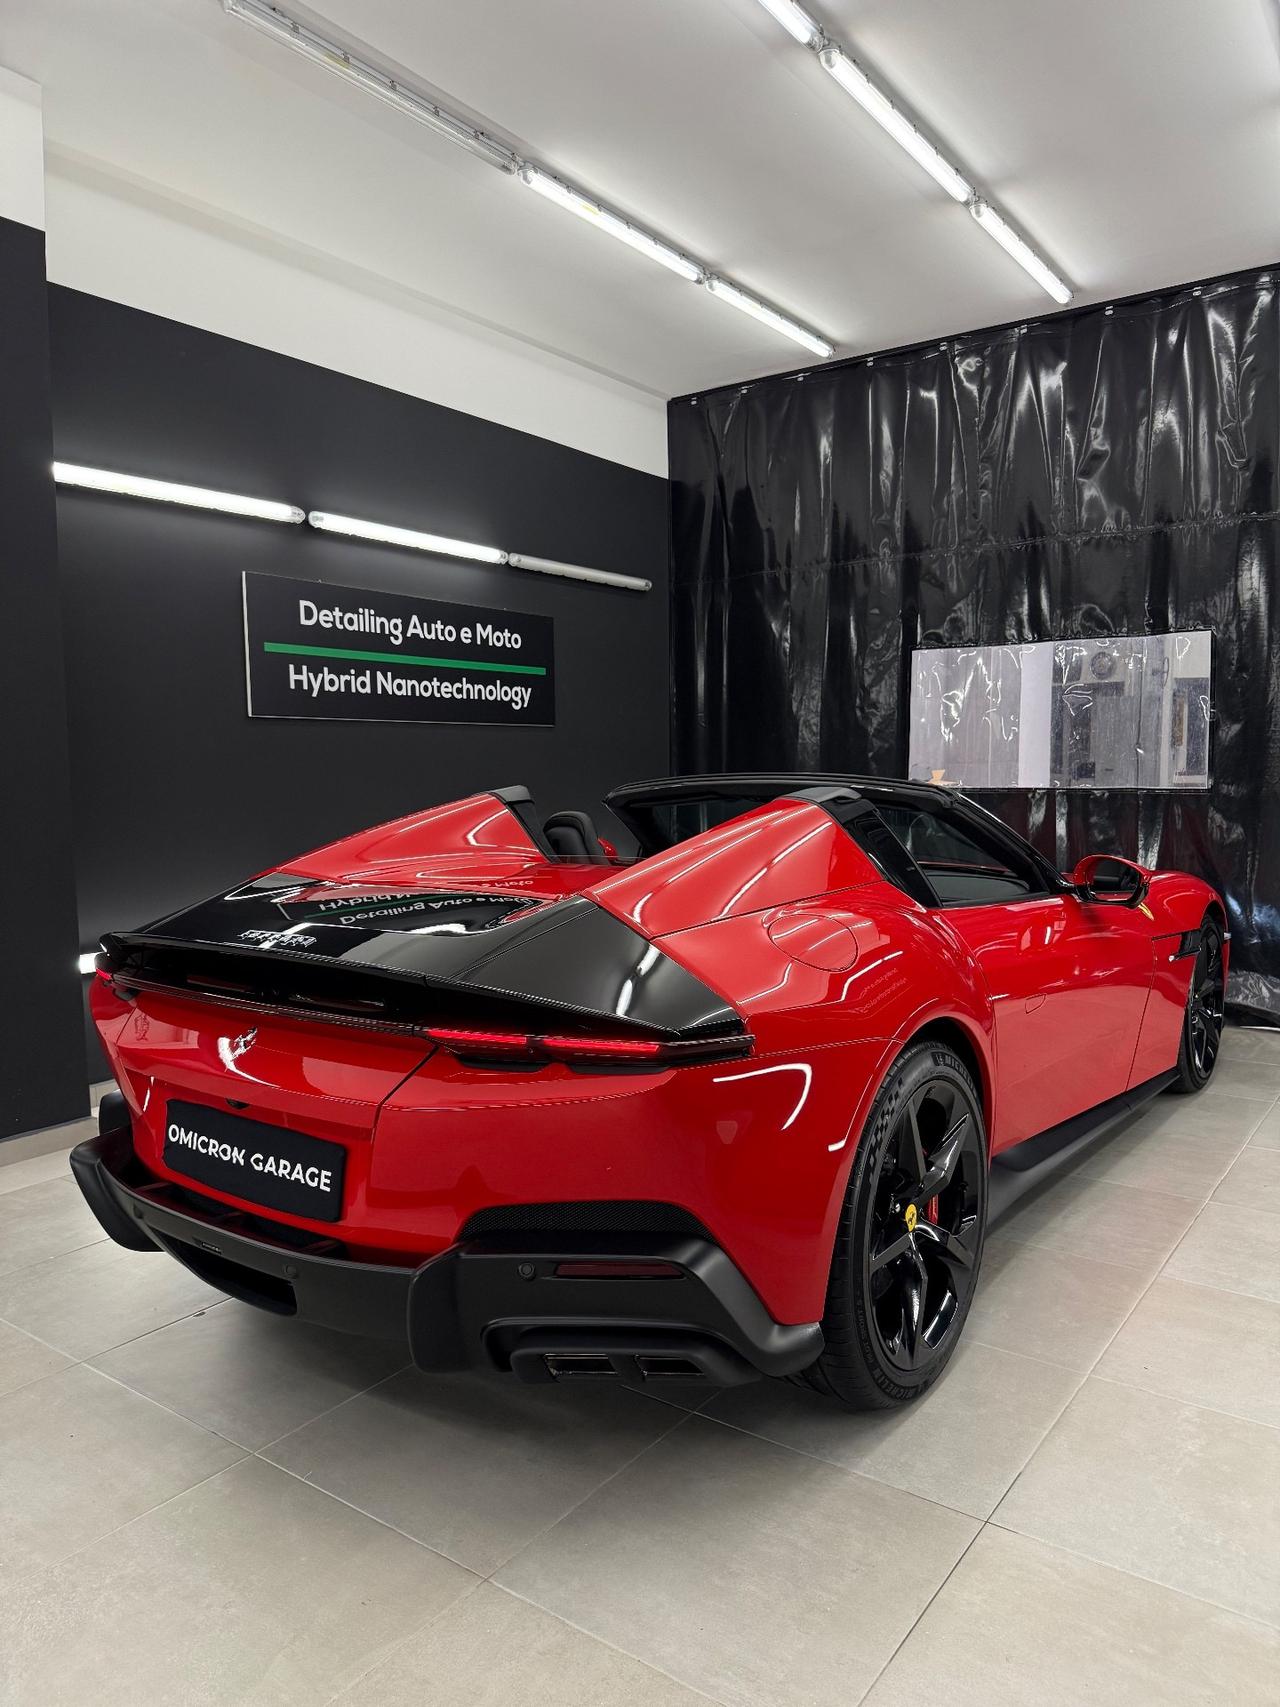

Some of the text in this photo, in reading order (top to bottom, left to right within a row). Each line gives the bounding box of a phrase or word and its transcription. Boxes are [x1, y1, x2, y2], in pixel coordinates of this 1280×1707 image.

[299, 599, 522, 649] Detailing Auto e Moto
[288, 664, 532, 710] Hybrid Nanotechnology
[167, 1123, 333, 1193] OMICRON GARAGE
